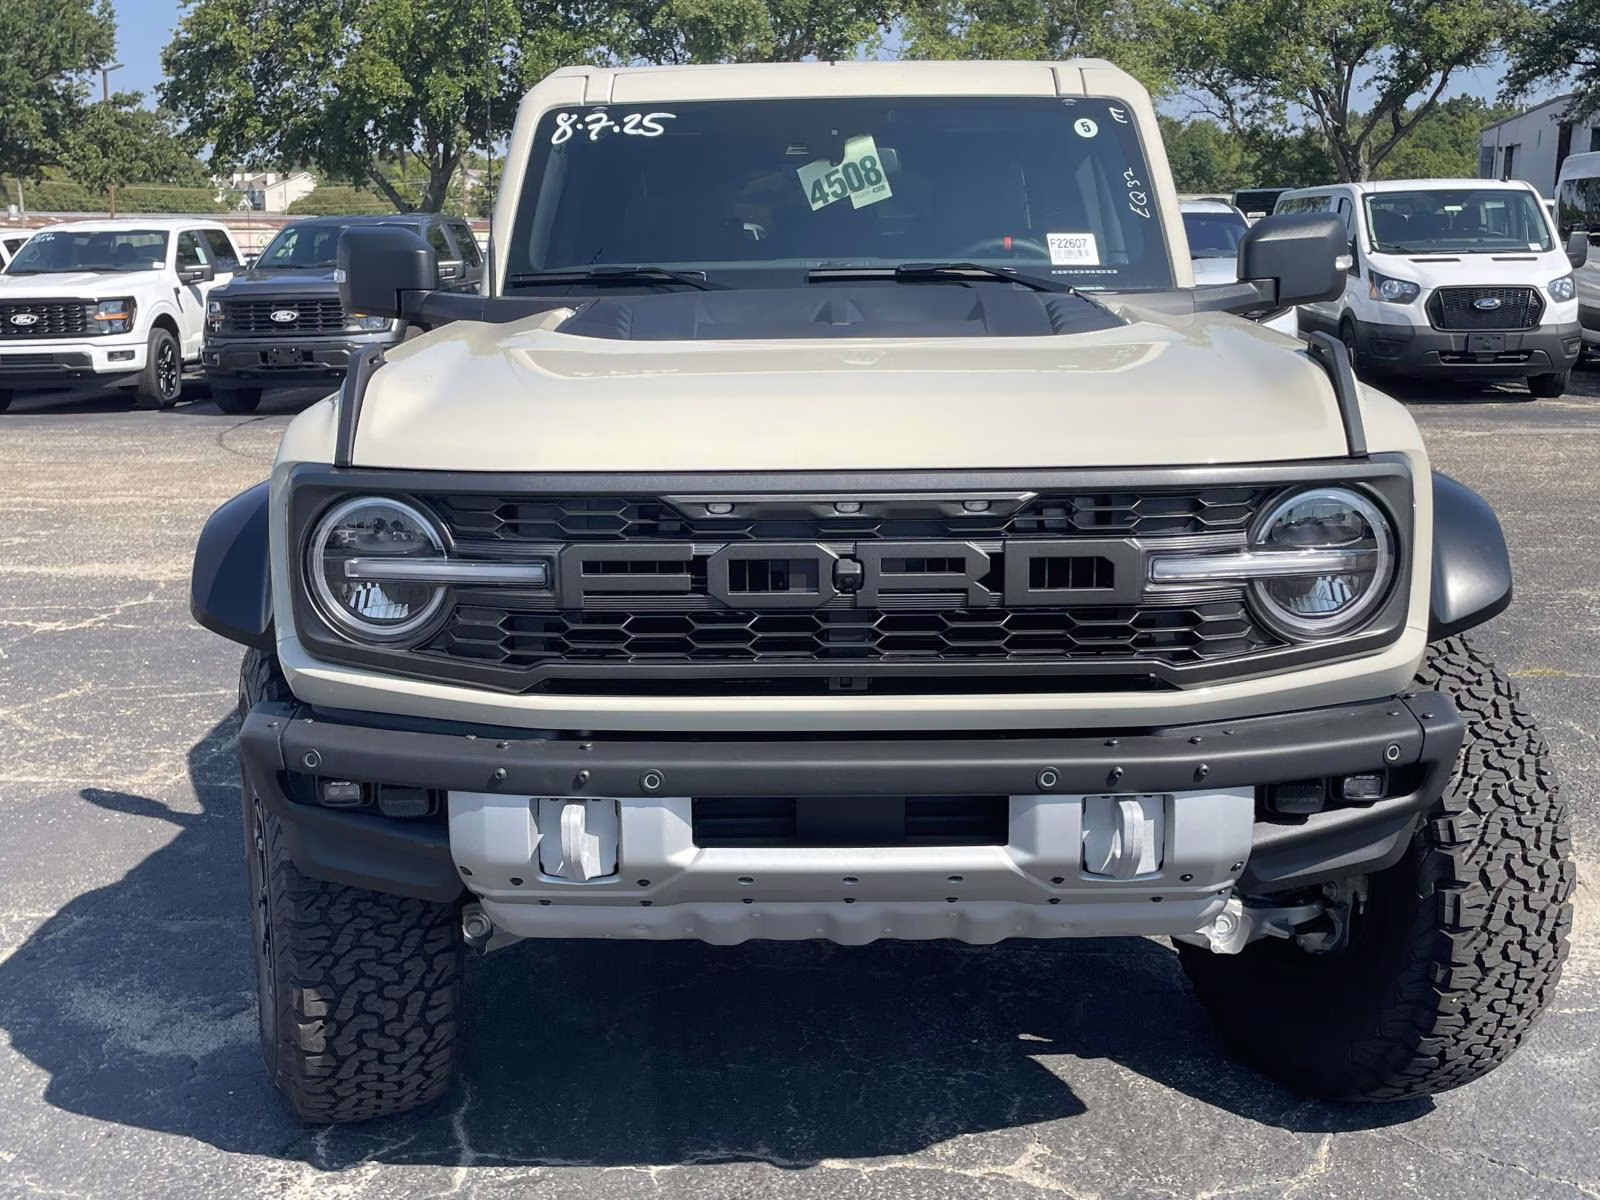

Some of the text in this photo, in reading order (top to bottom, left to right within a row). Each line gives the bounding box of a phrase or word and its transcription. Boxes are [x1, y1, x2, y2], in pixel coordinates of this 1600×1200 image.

[1081, 120, 1092, 133] 5
[810, 155, 883, 205] 4508
[1050, 238, 1088, 249] F22607
[559, 540, 1143, 610] FORD
